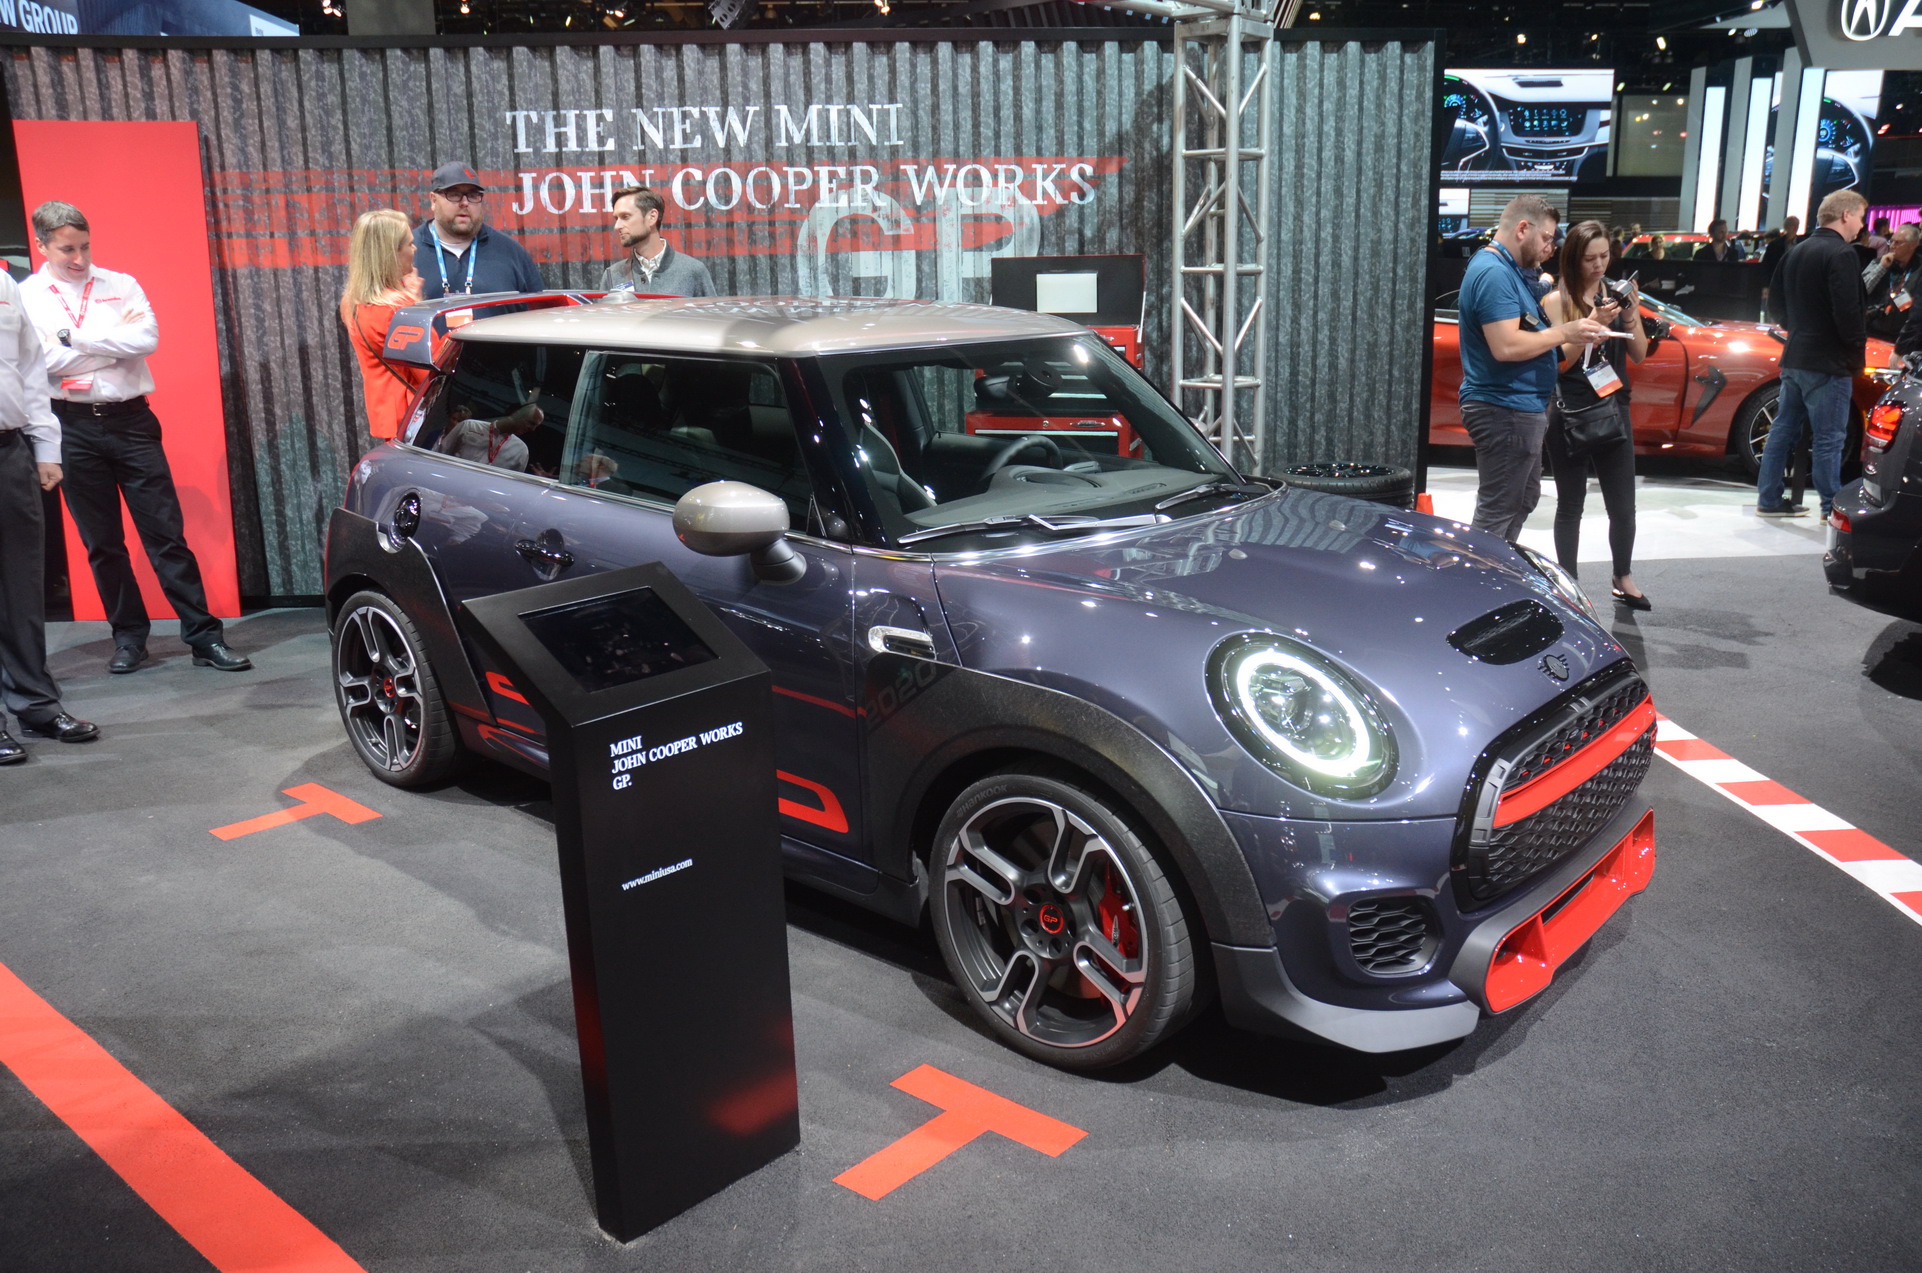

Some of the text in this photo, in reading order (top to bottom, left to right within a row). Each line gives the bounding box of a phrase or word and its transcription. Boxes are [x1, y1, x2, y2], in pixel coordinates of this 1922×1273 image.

[18, 0, 78, 34] GROUP
[505, 103, 904, 153] THE NEW MINI
[671, 164, 887, 211] COOPER
[899, 162, 1096, 207] WORKS
[797, 186, 1041, 304] GP
[387, 324, 425, 351] GP
[609, 735, 643, 758] MINI
[611, 722, 743, 774] JOHN COOPER WORKS
[612, 773, 633, 791] GP.
[621, 857, 693, 891] www.miniusa.com
[1043, 914, 1059, 924] GP
